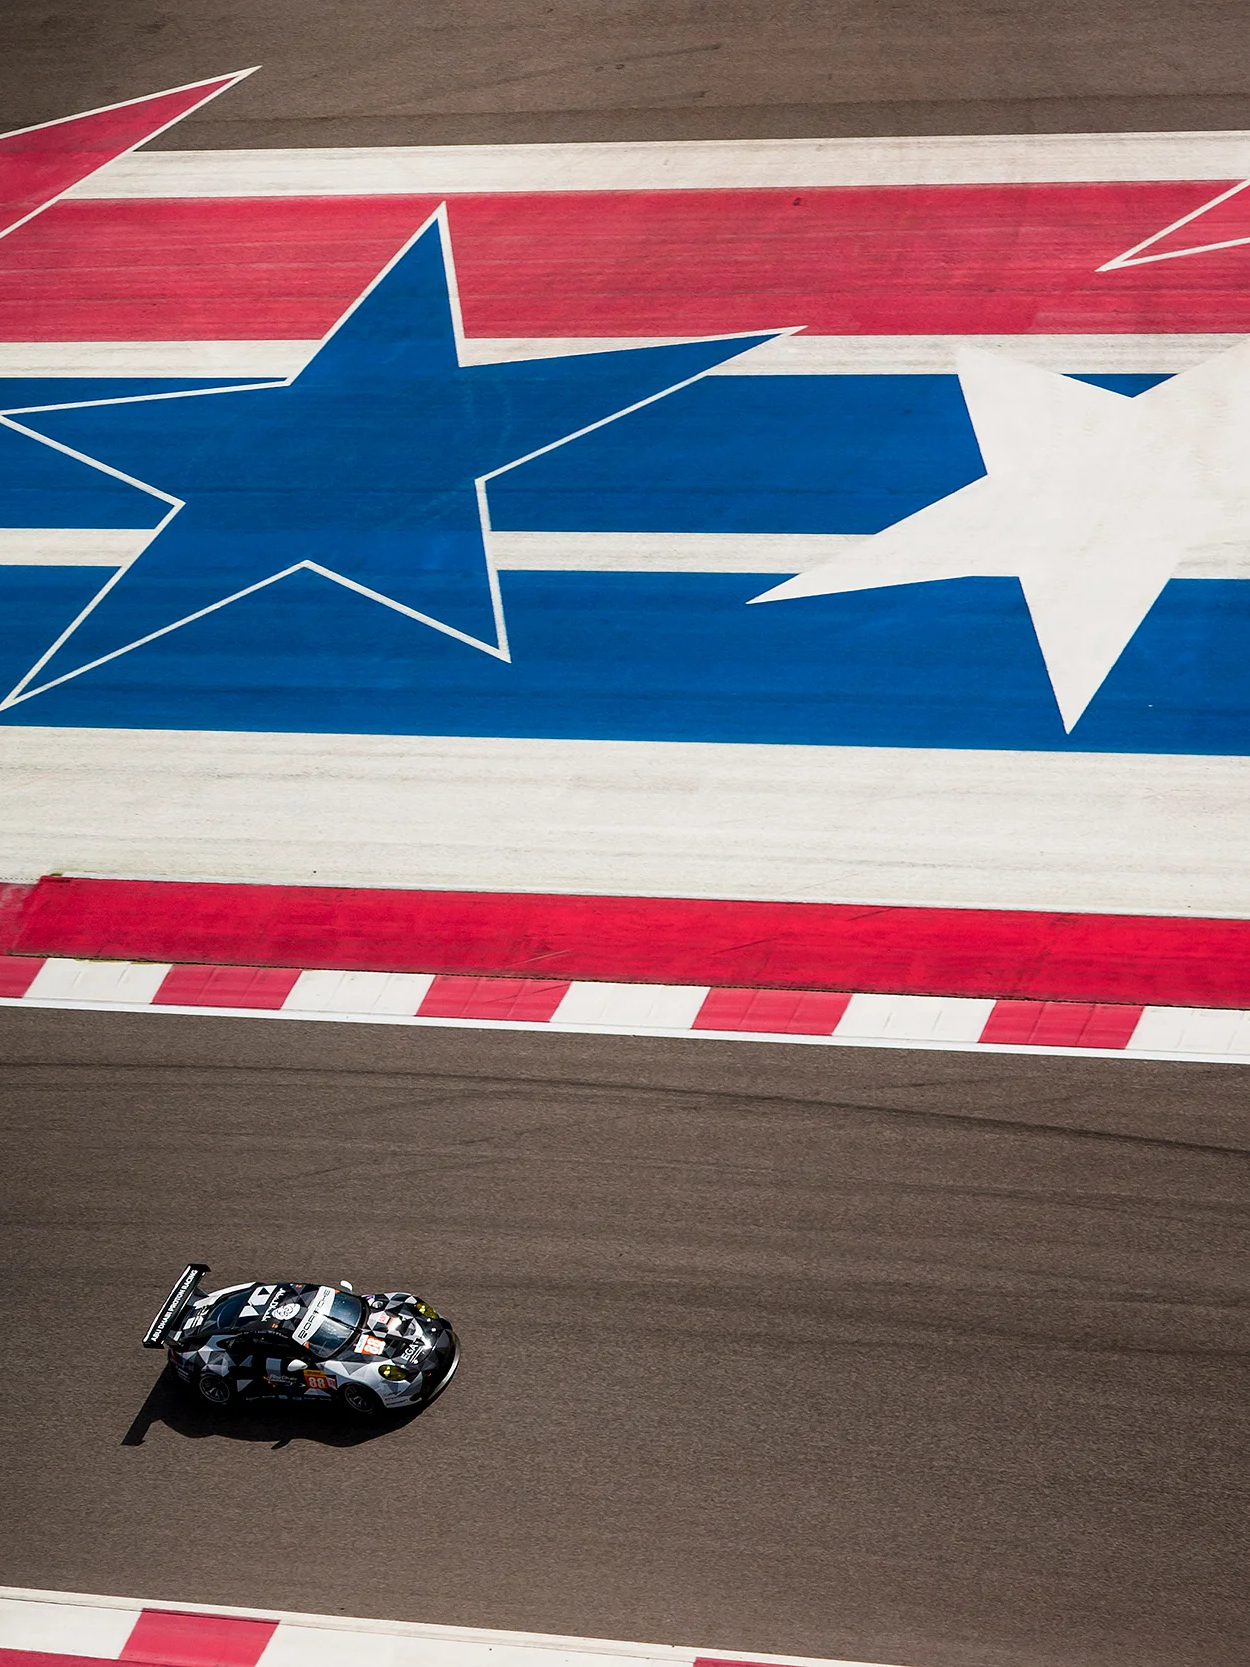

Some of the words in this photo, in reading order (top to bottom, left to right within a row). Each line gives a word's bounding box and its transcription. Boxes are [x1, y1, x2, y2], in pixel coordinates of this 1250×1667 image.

[151, 1329, 162, 1342] ABU
[158, 1311, 173, 1330] DHABI
[168, 1289, 186, 1312] PROTON
[181, 1269, 198, 1290] RACING
[363, 1337, 386, 1355] 88
[308, 1376, 326, 1389] 88
